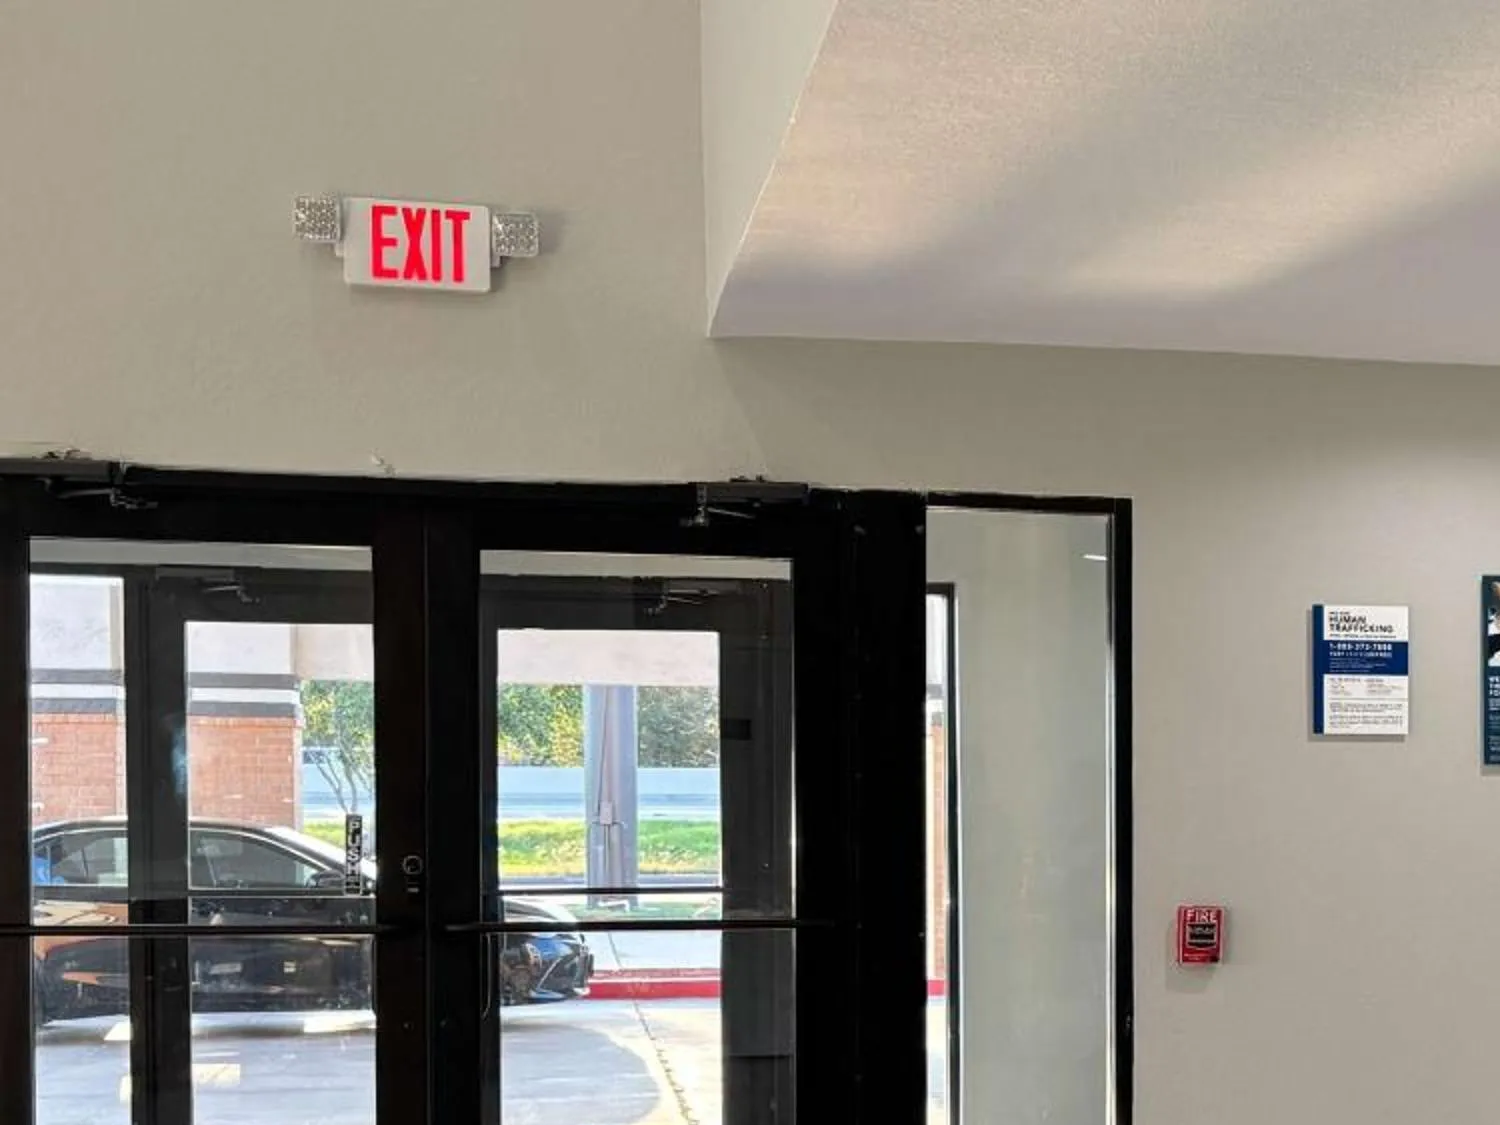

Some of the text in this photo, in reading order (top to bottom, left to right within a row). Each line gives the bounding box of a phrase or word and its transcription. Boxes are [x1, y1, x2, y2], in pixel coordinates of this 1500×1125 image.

[371, 204, 470, 283] EXIT
[1329, 615, 1367, 624] HUMAN
[1329, 623, 1393, 633] TRAFFICKING
[347, 821, 360, 875] PUSH
[1186, 909, 1217, 923] FIRE
